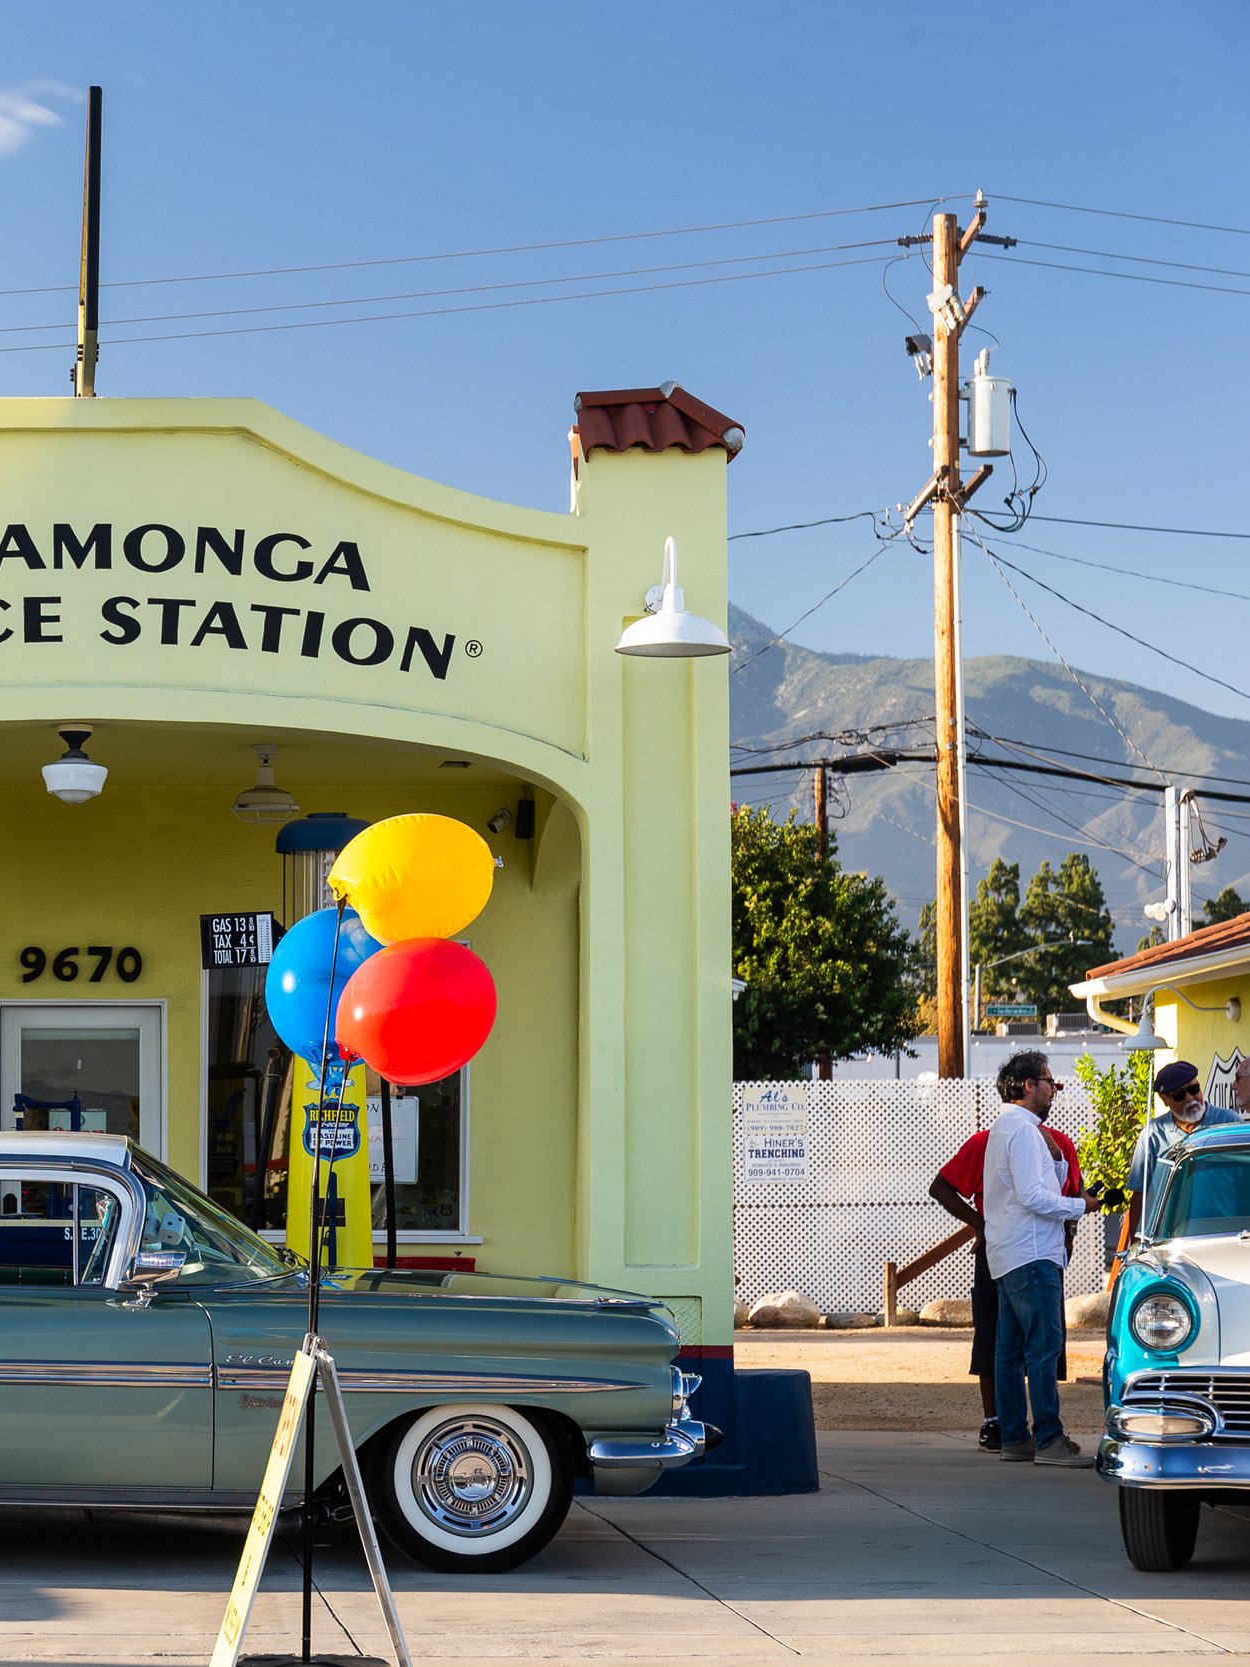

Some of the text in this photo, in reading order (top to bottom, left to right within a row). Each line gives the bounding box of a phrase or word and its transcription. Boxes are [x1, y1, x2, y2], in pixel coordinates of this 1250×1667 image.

[212, 918, 232, 933] GAS
[234, 917, 247, 932] 13
[213, 934, 232, 949] TAX
[240, 933, 247, 947] 4
[213, 949, 234, 965] TOTAL
[235, 949, 247, 964] 17
[20, 946, 142, 983] 9670
[759, 1089, 789, 1103] Al's
[746, 1102, 788, 1111] PLUMBING
[310, 1109, 355, 1121] RIHFELD
[764, 1137, 804, 1148] HINER'S
[748, 1148, 805, 1159] TRENCHING
[748, 1168, 805, 1176] 909-941-0704
[225, 1353, 254, 1366] El
